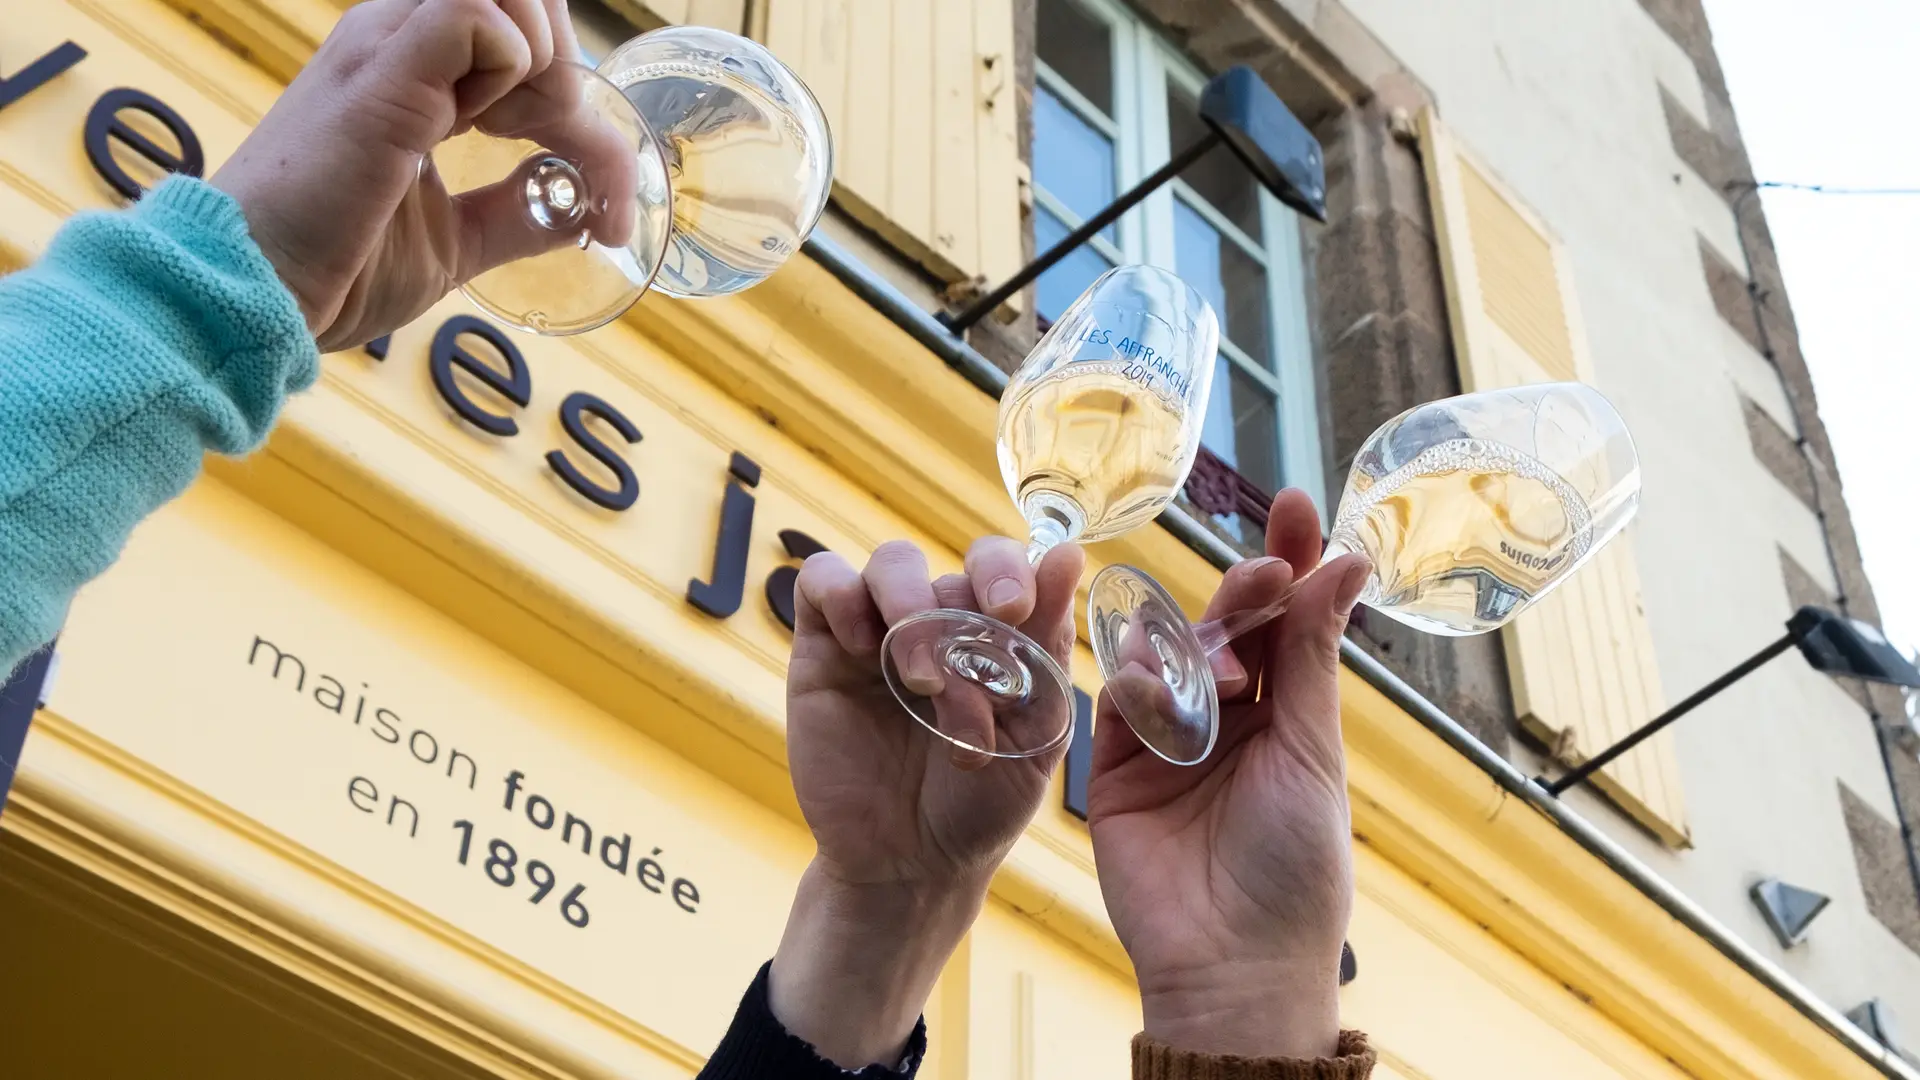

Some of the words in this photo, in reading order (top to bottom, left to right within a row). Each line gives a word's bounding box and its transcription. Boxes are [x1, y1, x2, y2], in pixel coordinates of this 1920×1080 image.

[364, 313, 644, 512] es
[1080, 329, 1112, 345] LES
[1122, 360, 1154, 389] 2019
[247, 635, 478, 790] maison
[502, 769, 701, 914] fondée
[347, 775, 420, 838] en
[452, 819, 590, 929] 1896
